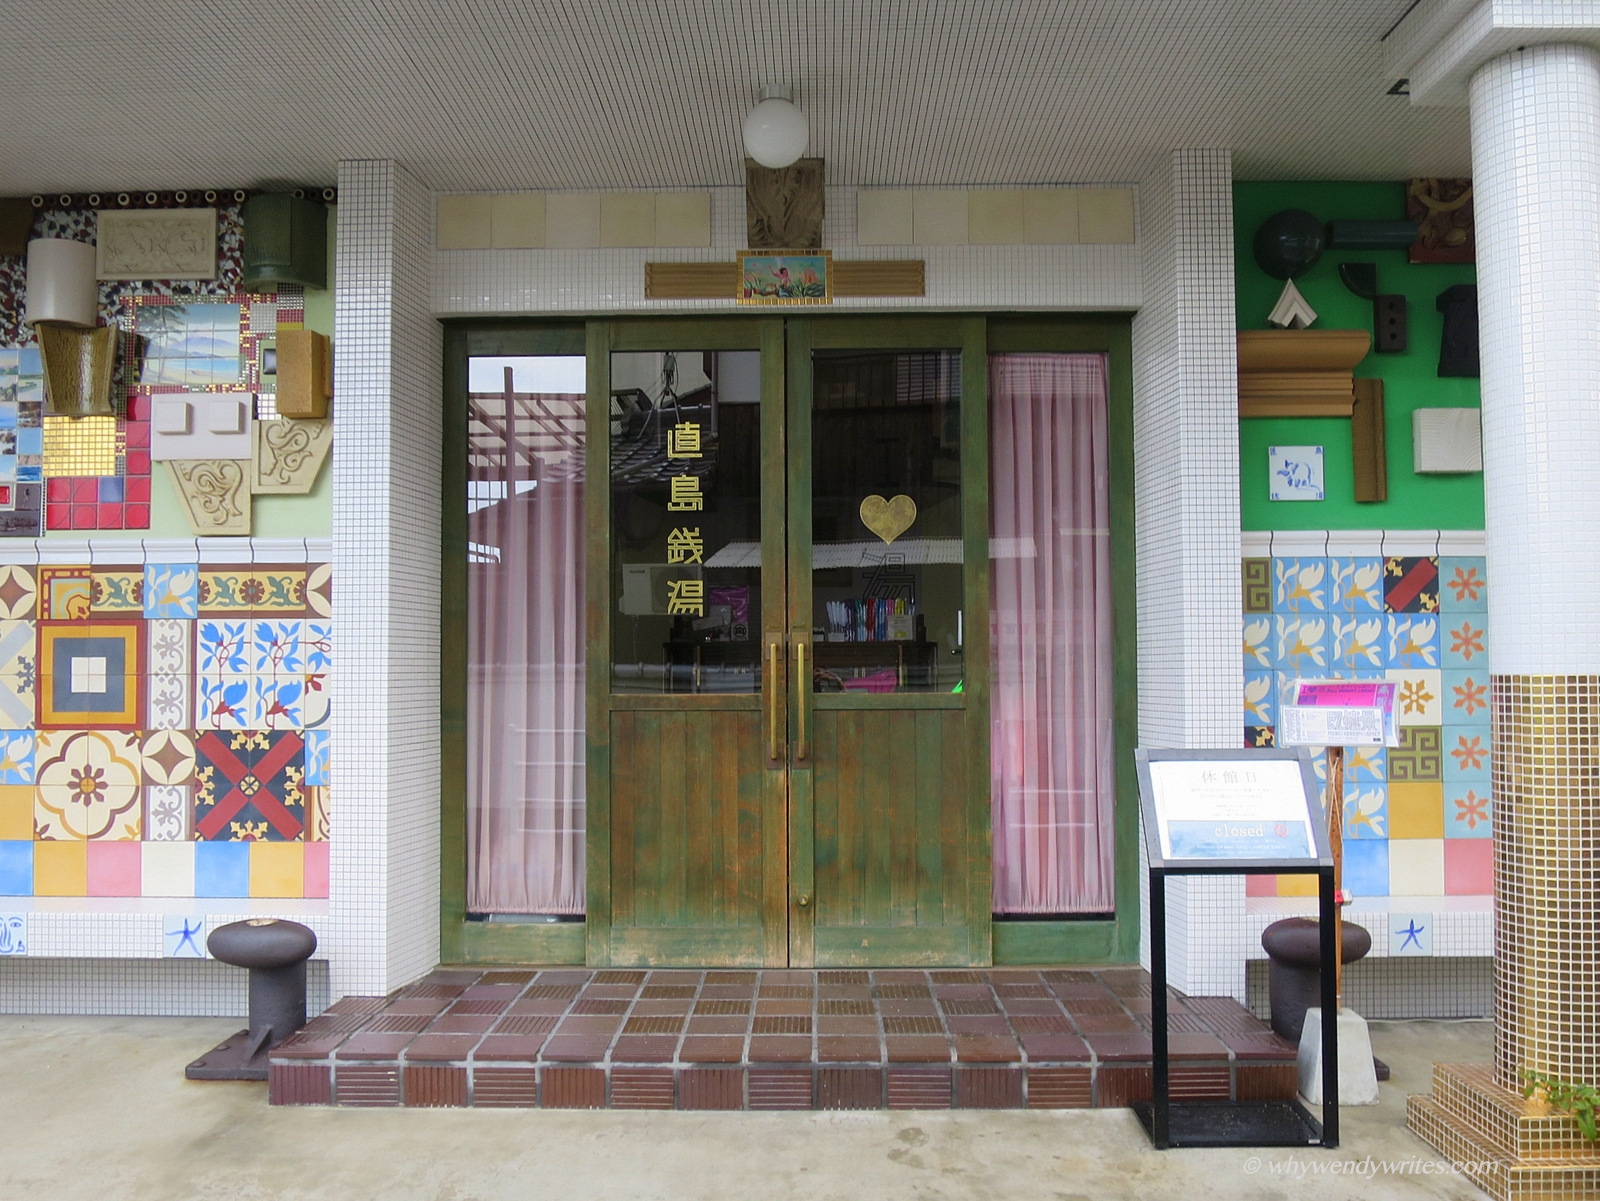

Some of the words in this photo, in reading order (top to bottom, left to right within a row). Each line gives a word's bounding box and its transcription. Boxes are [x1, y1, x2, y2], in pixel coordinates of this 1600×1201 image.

[1201, 770, 1257, 784] 休館日
[1214, 823, 1265, 837] closed
